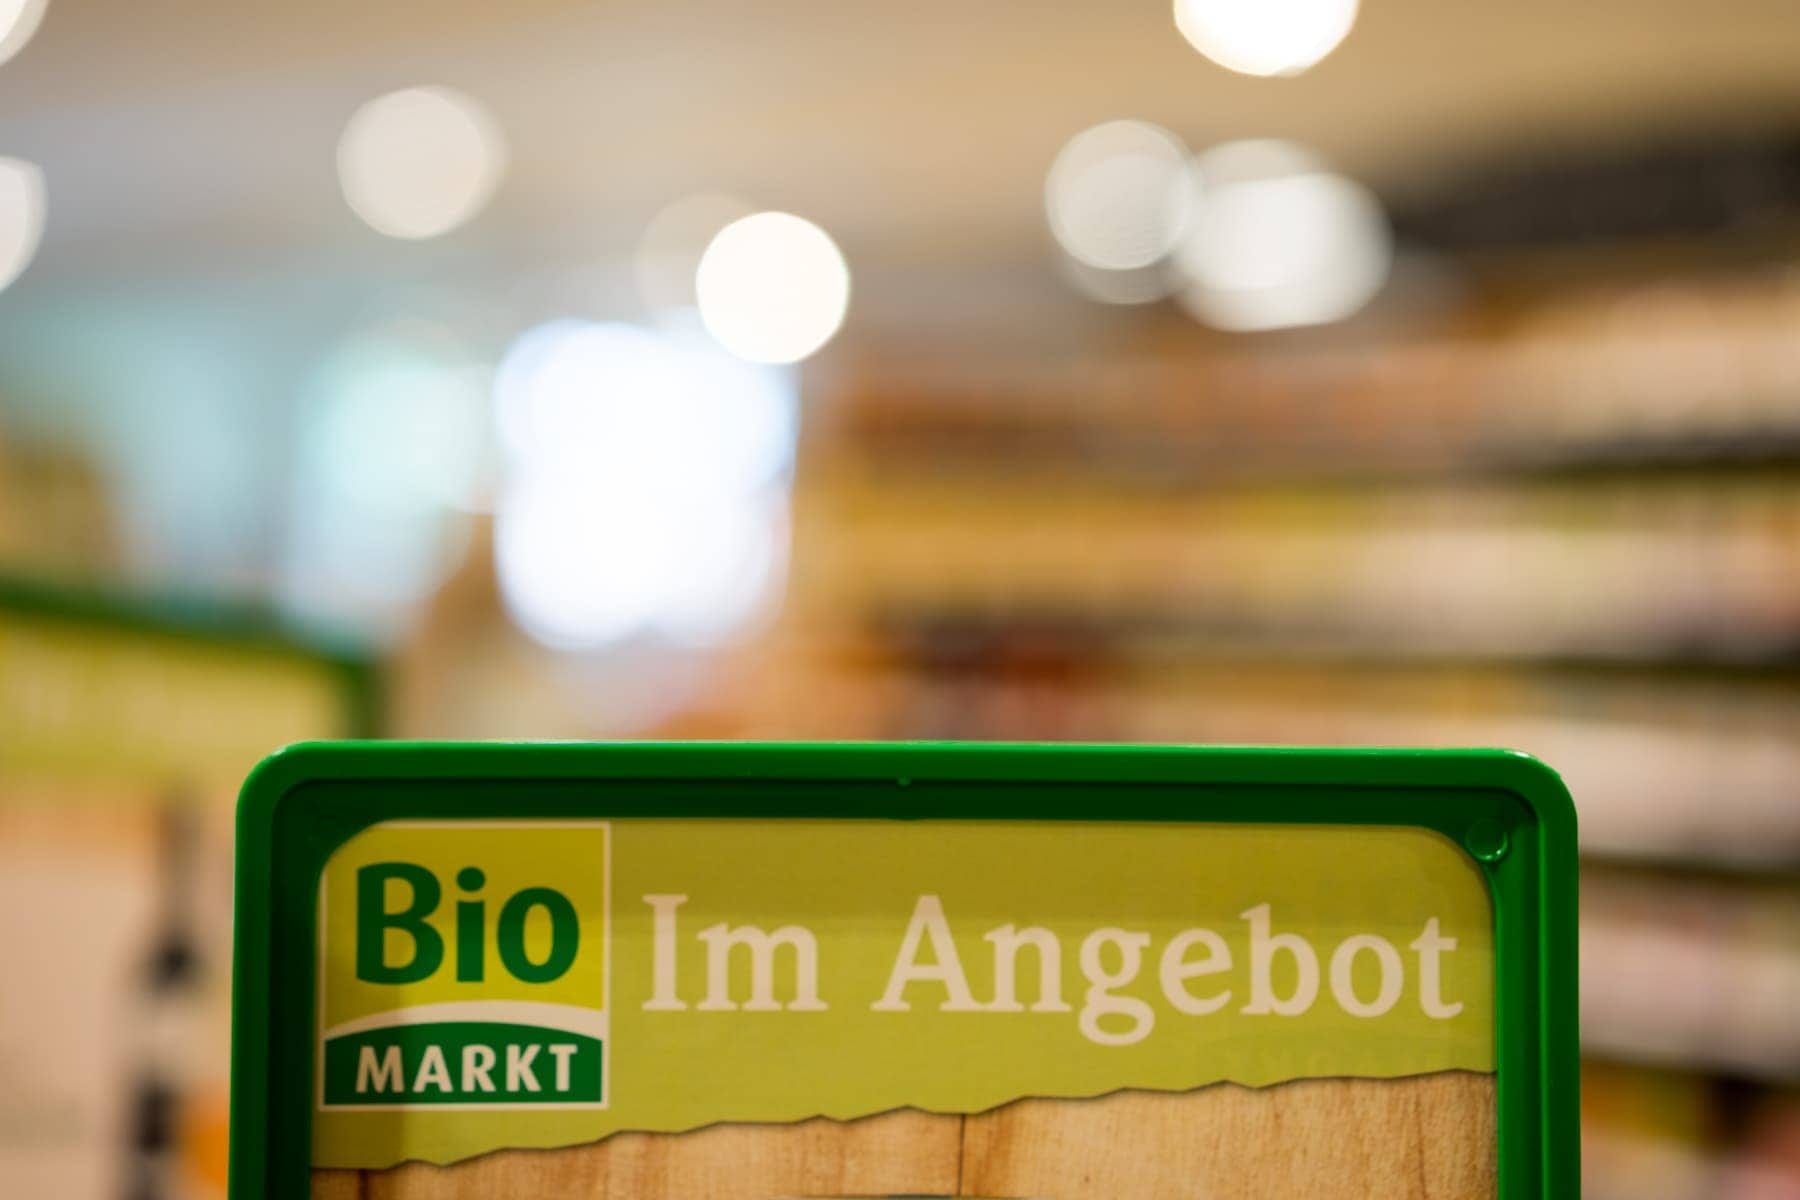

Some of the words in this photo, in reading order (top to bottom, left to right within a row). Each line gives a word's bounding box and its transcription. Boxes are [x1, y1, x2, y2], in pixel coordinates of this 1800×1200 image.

[356, 861, 580, 986] Bio
[642, 893, 829, 1012] Im
[870, 894, 1464, 1046] Angebot
[355, 1044, 579, 1093] MARKT
